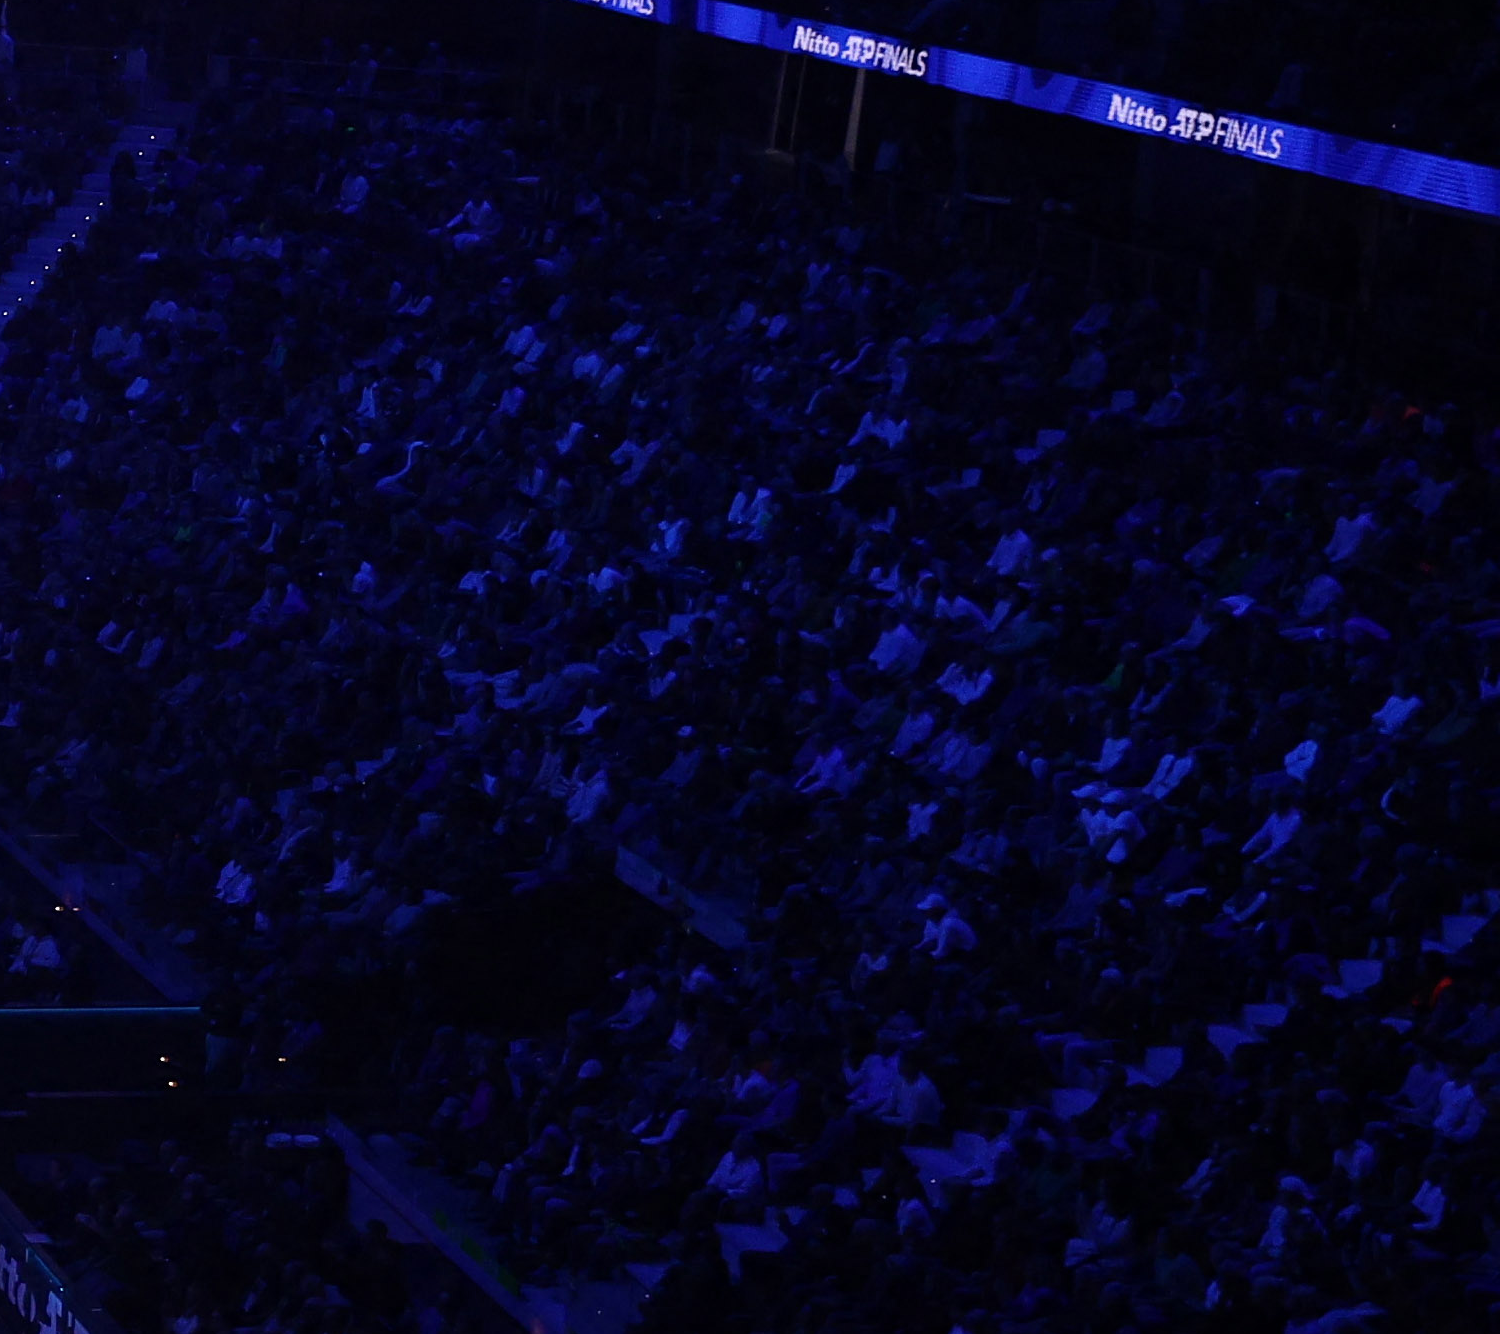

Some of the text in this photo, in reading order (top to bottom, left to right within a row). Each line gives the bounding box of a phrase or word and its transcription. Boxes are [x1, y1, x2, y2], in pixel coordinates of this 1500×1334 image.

[793, 24, 929, 78] Nitto ATP FINALS
[1106, 93, 1285, 160] Nitto ATP FINALS
